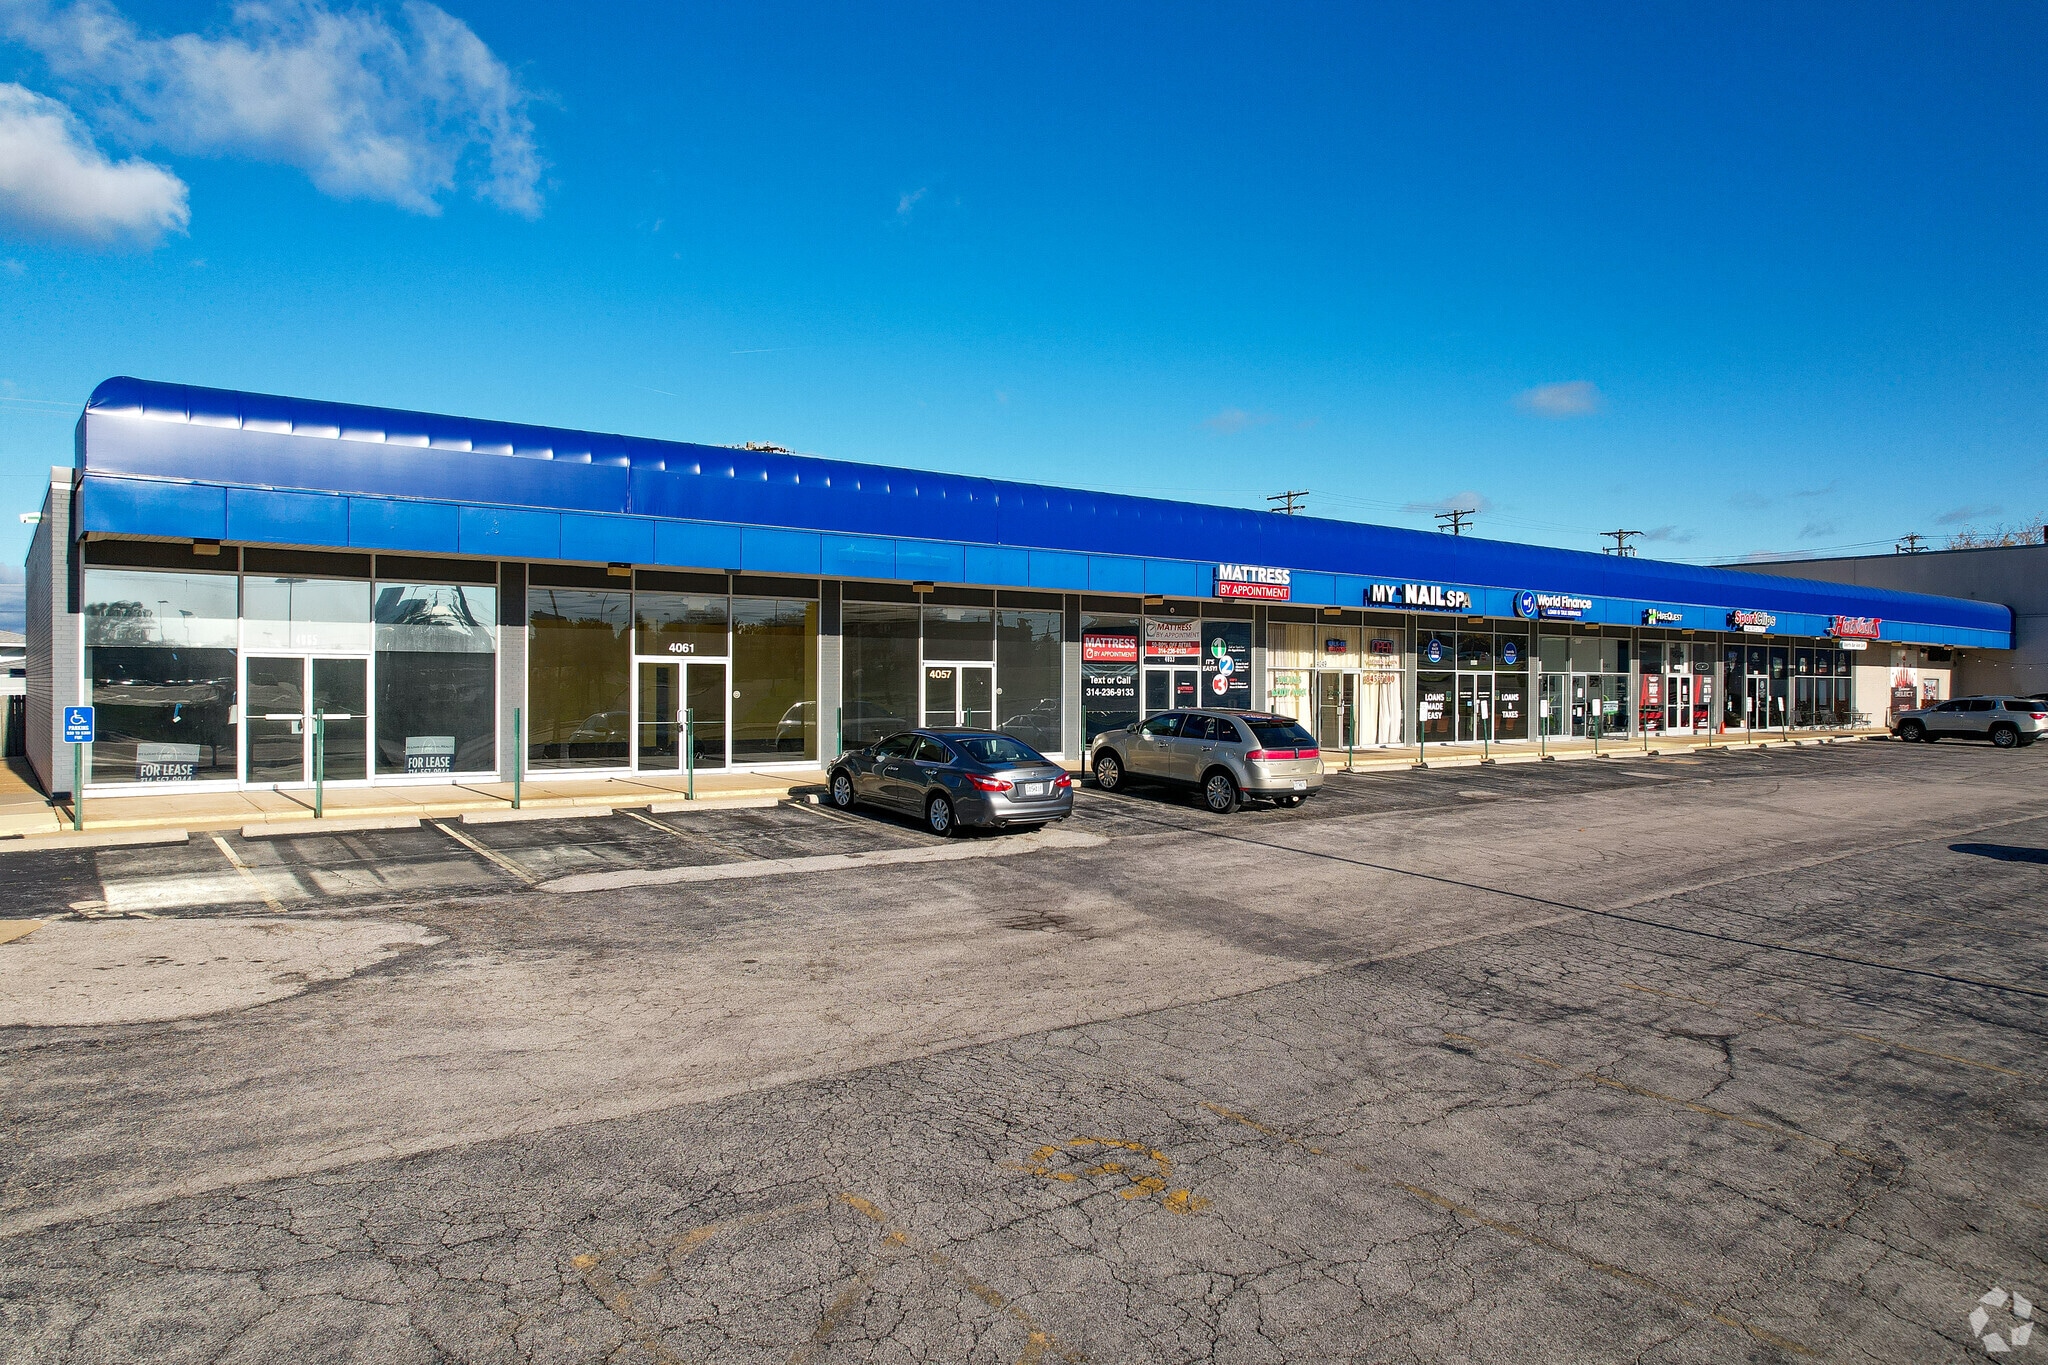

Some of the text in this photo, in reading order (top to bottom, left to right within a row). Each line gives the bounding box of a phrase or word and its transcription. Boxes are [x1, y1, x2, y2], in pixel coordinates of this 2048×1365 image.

[1219, 564, 1290, 585] MATTRESS
[1220, 584, 1288, 598] BY APPOINTMENT
[1372, 583, 1472, 609] MY NAIL SPA
[1537, 594, 1593, 610] World Finance
[1156, 623, 1193, 631] MATTRESS
[668, 642, 695, 653] 4061
[1085, 637, 1136, 649] MATTRESS
[1373, 641, 1392, 654] OPEN
[1101, 650, 1136, 658] APPOINTMENT
[929, 669, 952, 679] 4057
[1089, 675, 1105, 685] Text
[1116, 675, 1131, 685] Call
[1085, 687, 1135, 697] 314-236-9133
[1424, 693, 1445, 702] LOANS
[1501, 693, 1520, 702] LOANS
[1427, 711, 1443, 720] EASY
[1501, 710, 1519, 719] TAXES
[408, 756, 451, 769] FOR LEASE
[140, 763, 193, 777] FOR LEASE
